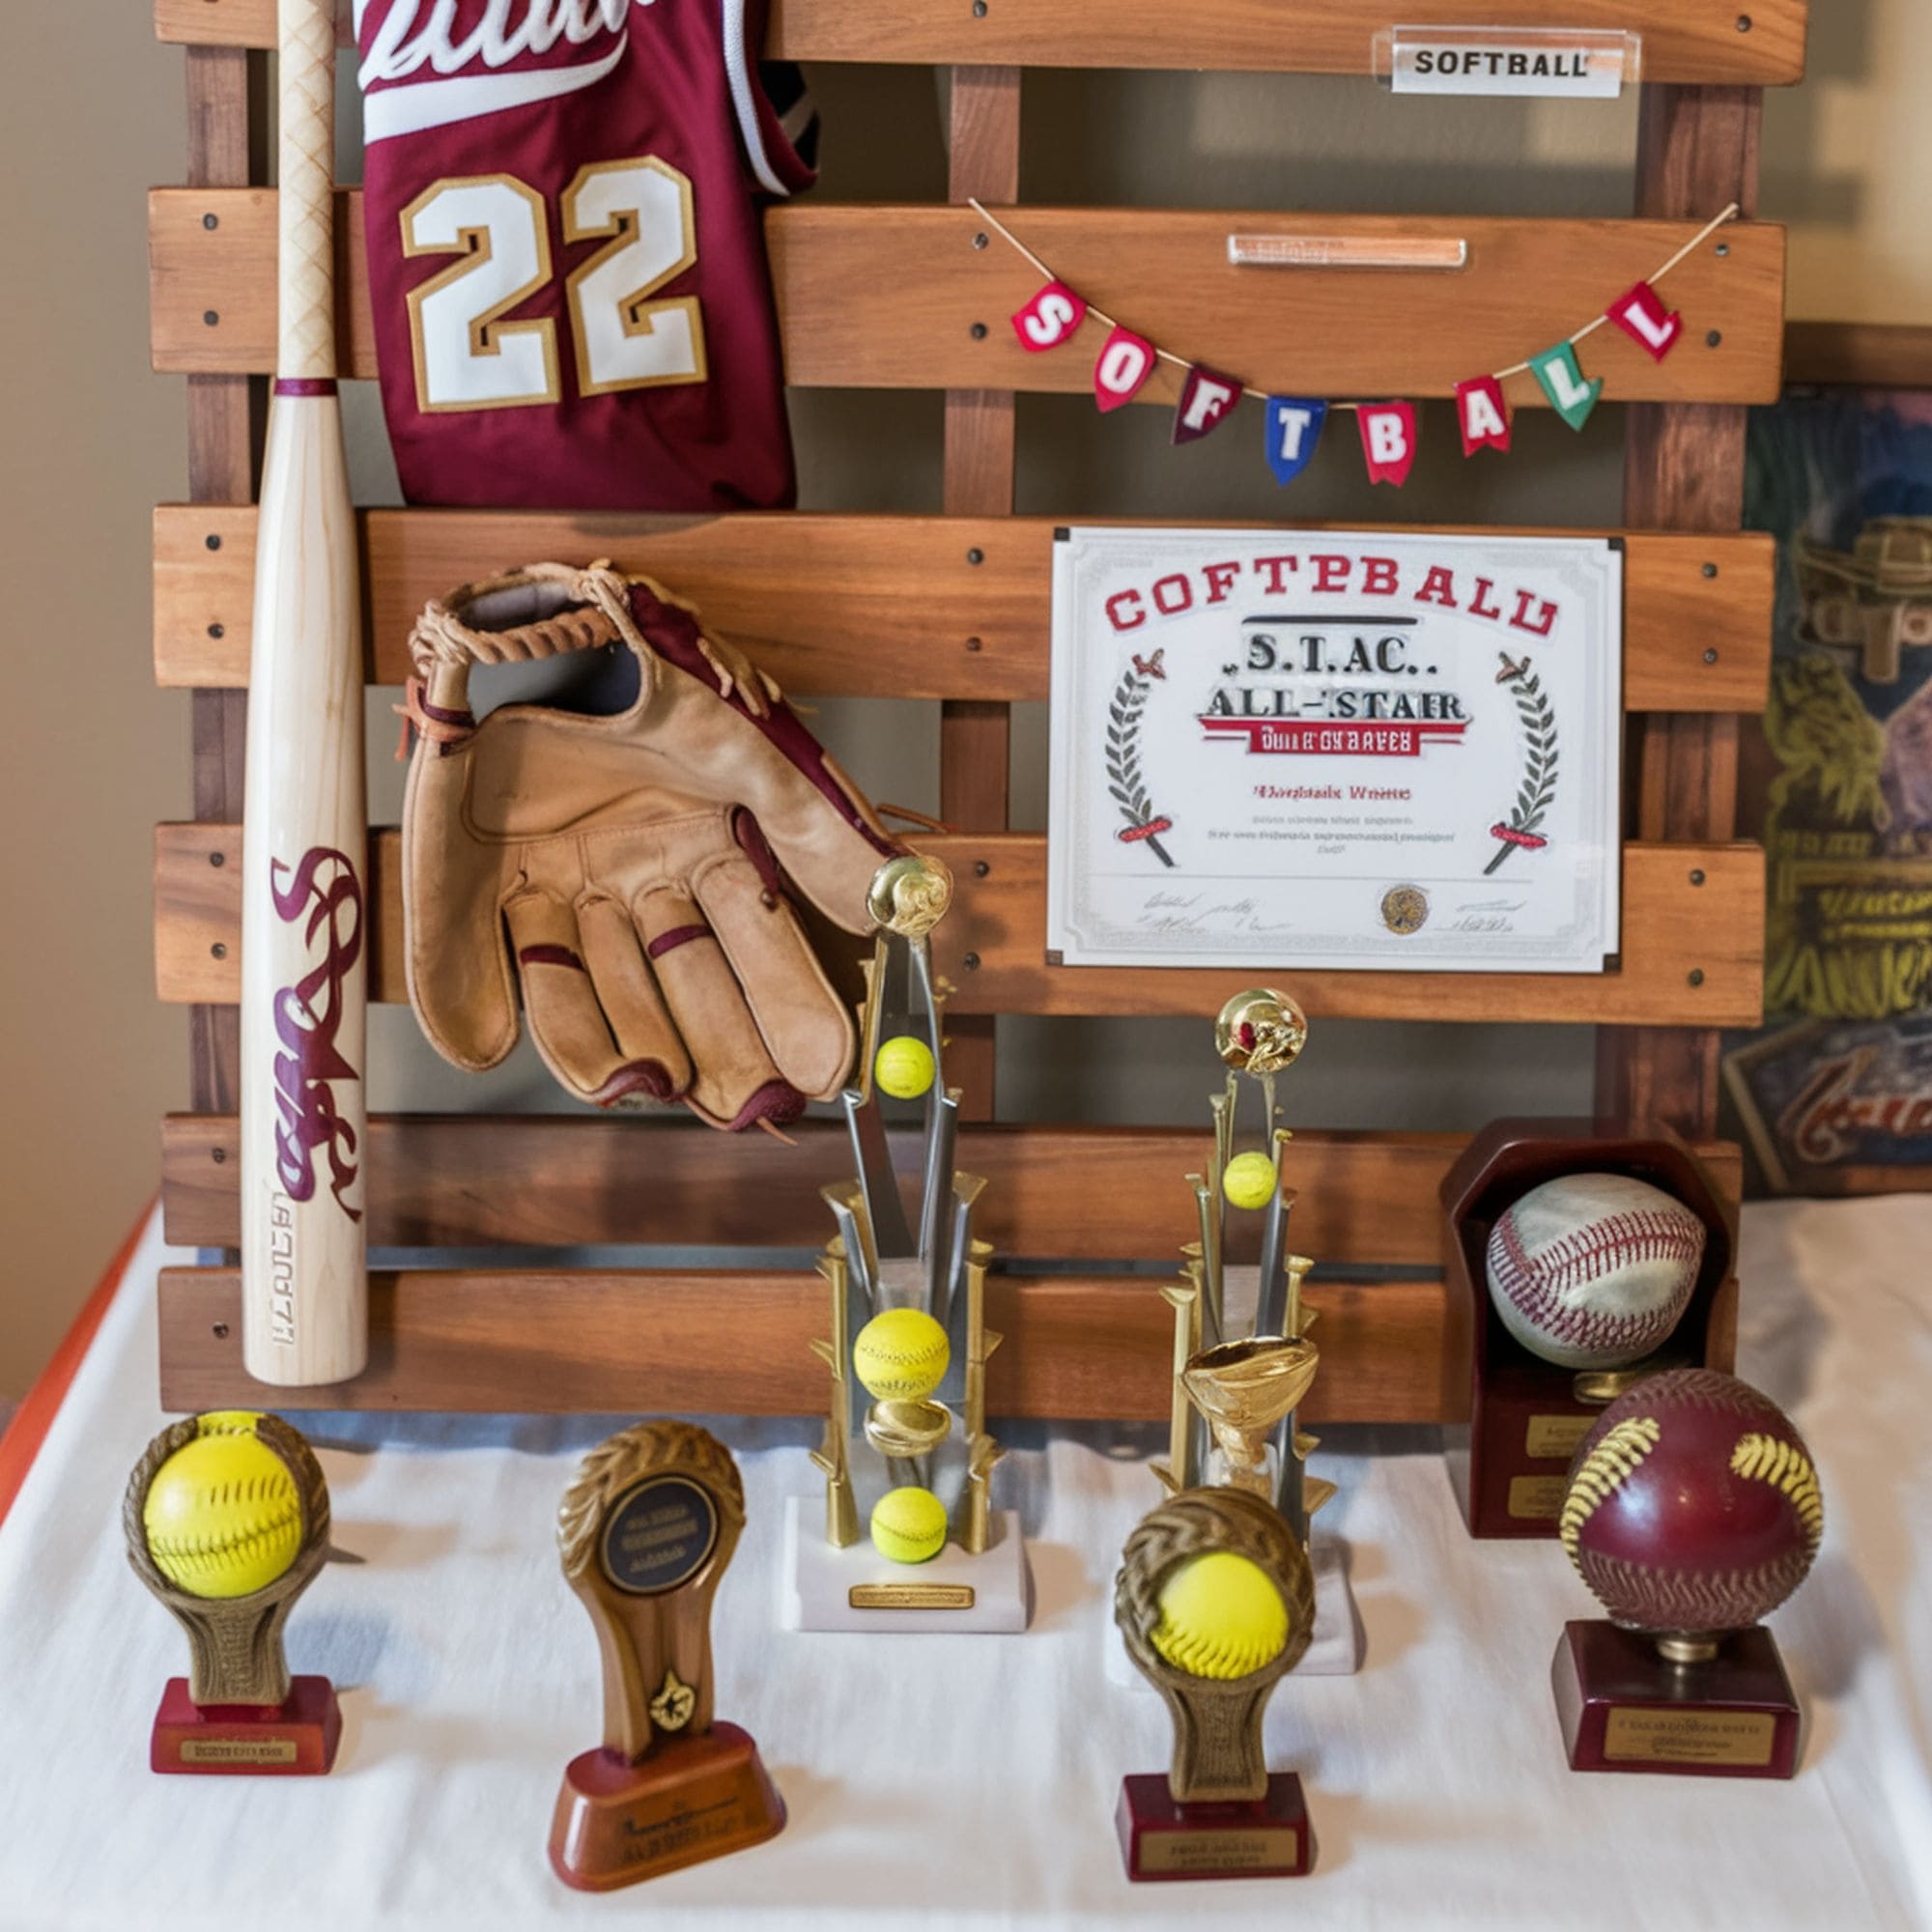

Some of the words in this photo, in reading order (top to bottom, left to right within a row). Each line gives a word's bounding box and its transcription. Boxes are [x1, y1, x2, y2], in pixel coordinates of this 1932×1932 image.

[1414, 49, 1588, 77] SOFTBALL
[399, 155, 708, 413] 22
[1024, 293, 1674, 464] SOFTBALL
